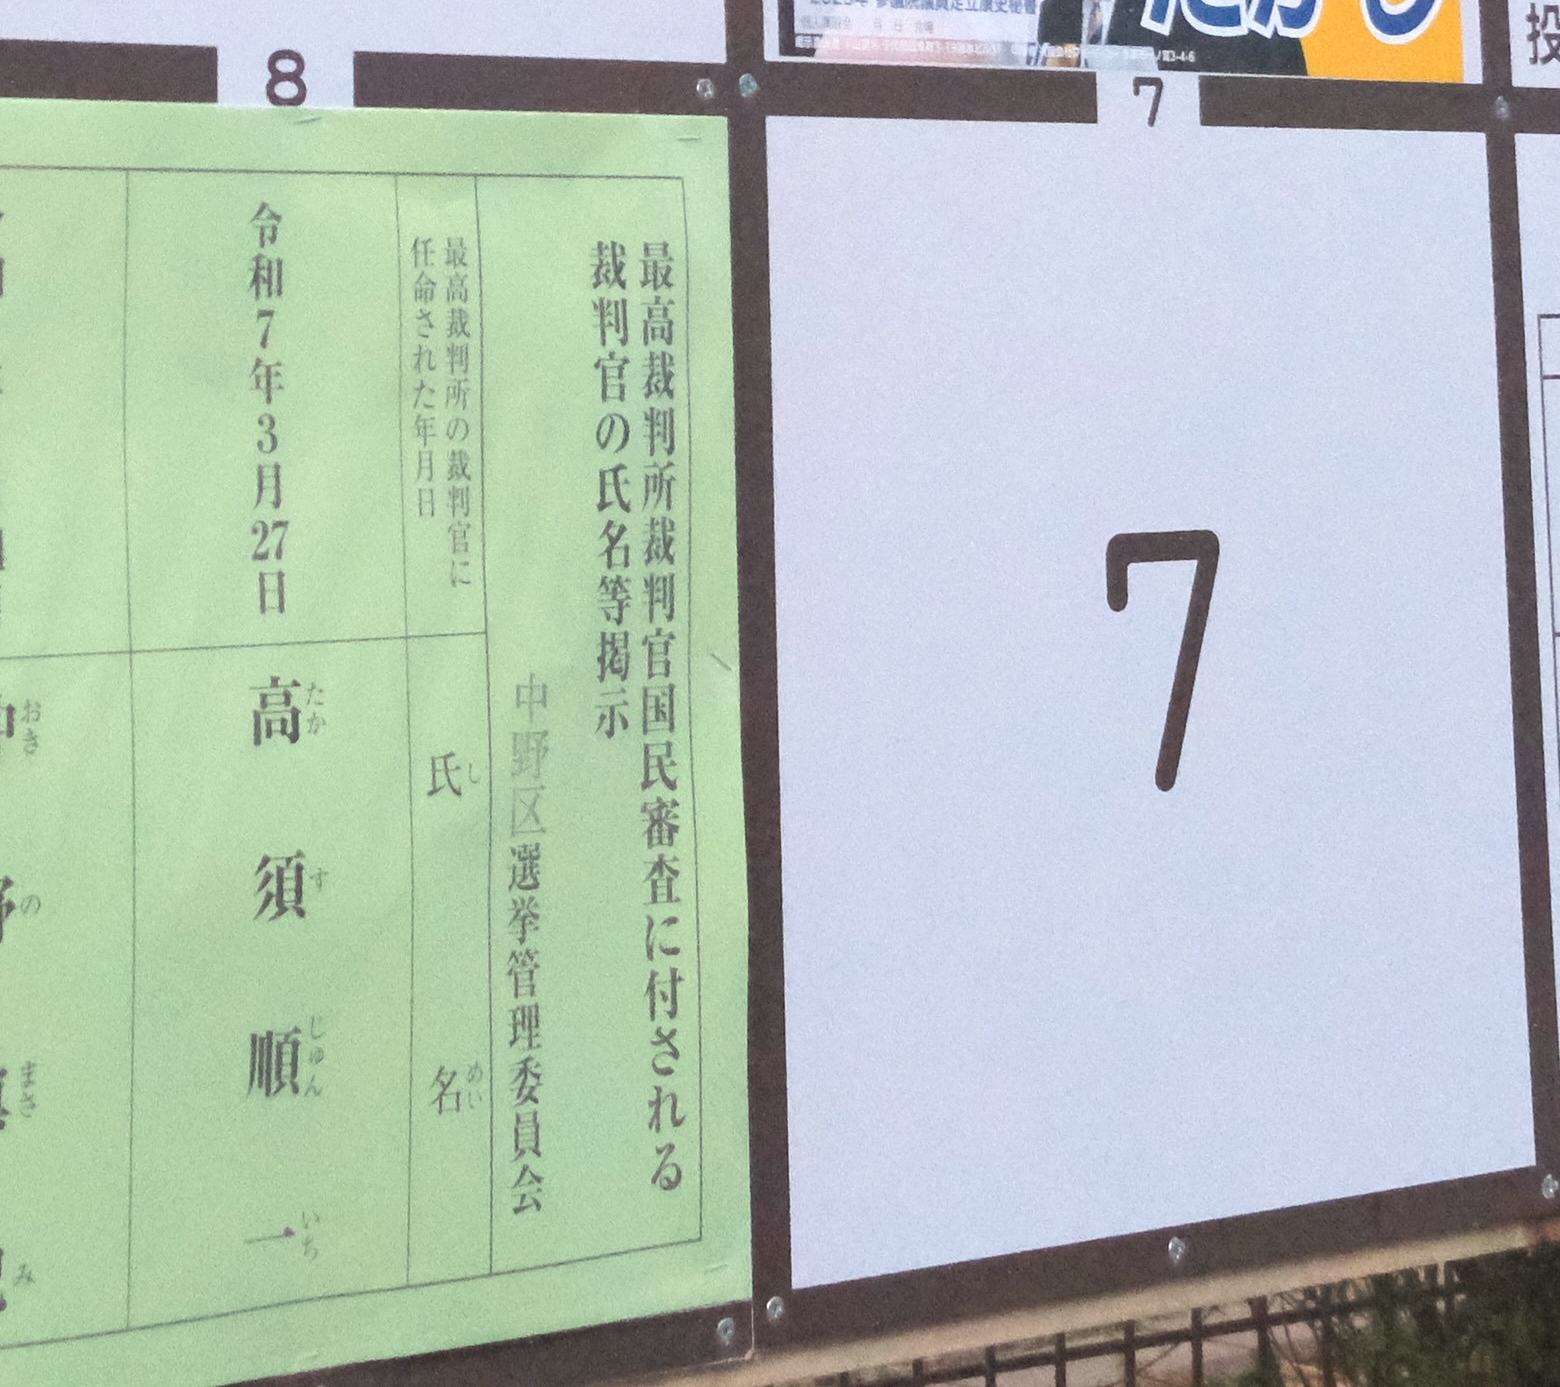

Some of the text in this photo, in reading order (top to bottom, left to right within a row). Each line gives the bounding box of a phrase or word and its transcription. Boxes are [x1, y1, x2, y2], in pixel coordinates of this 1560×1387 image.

[265, 49, 308, 109] 8
[1132, 76, 1165, 128] 7
[409, 235, 440, 521] 任命された年月日
[442, 236, 474, 588] 最高裁判所の裁判官に
[589, 240, 633, 739] 裁判官の氏名等掲示
[637, 240, 686, 1194] 最高裁判所裁判官国民審査に付される
[1105, 529, 1221, 793] 7
[505, 671, 549, 1217] 中野区選挙管理委員会
